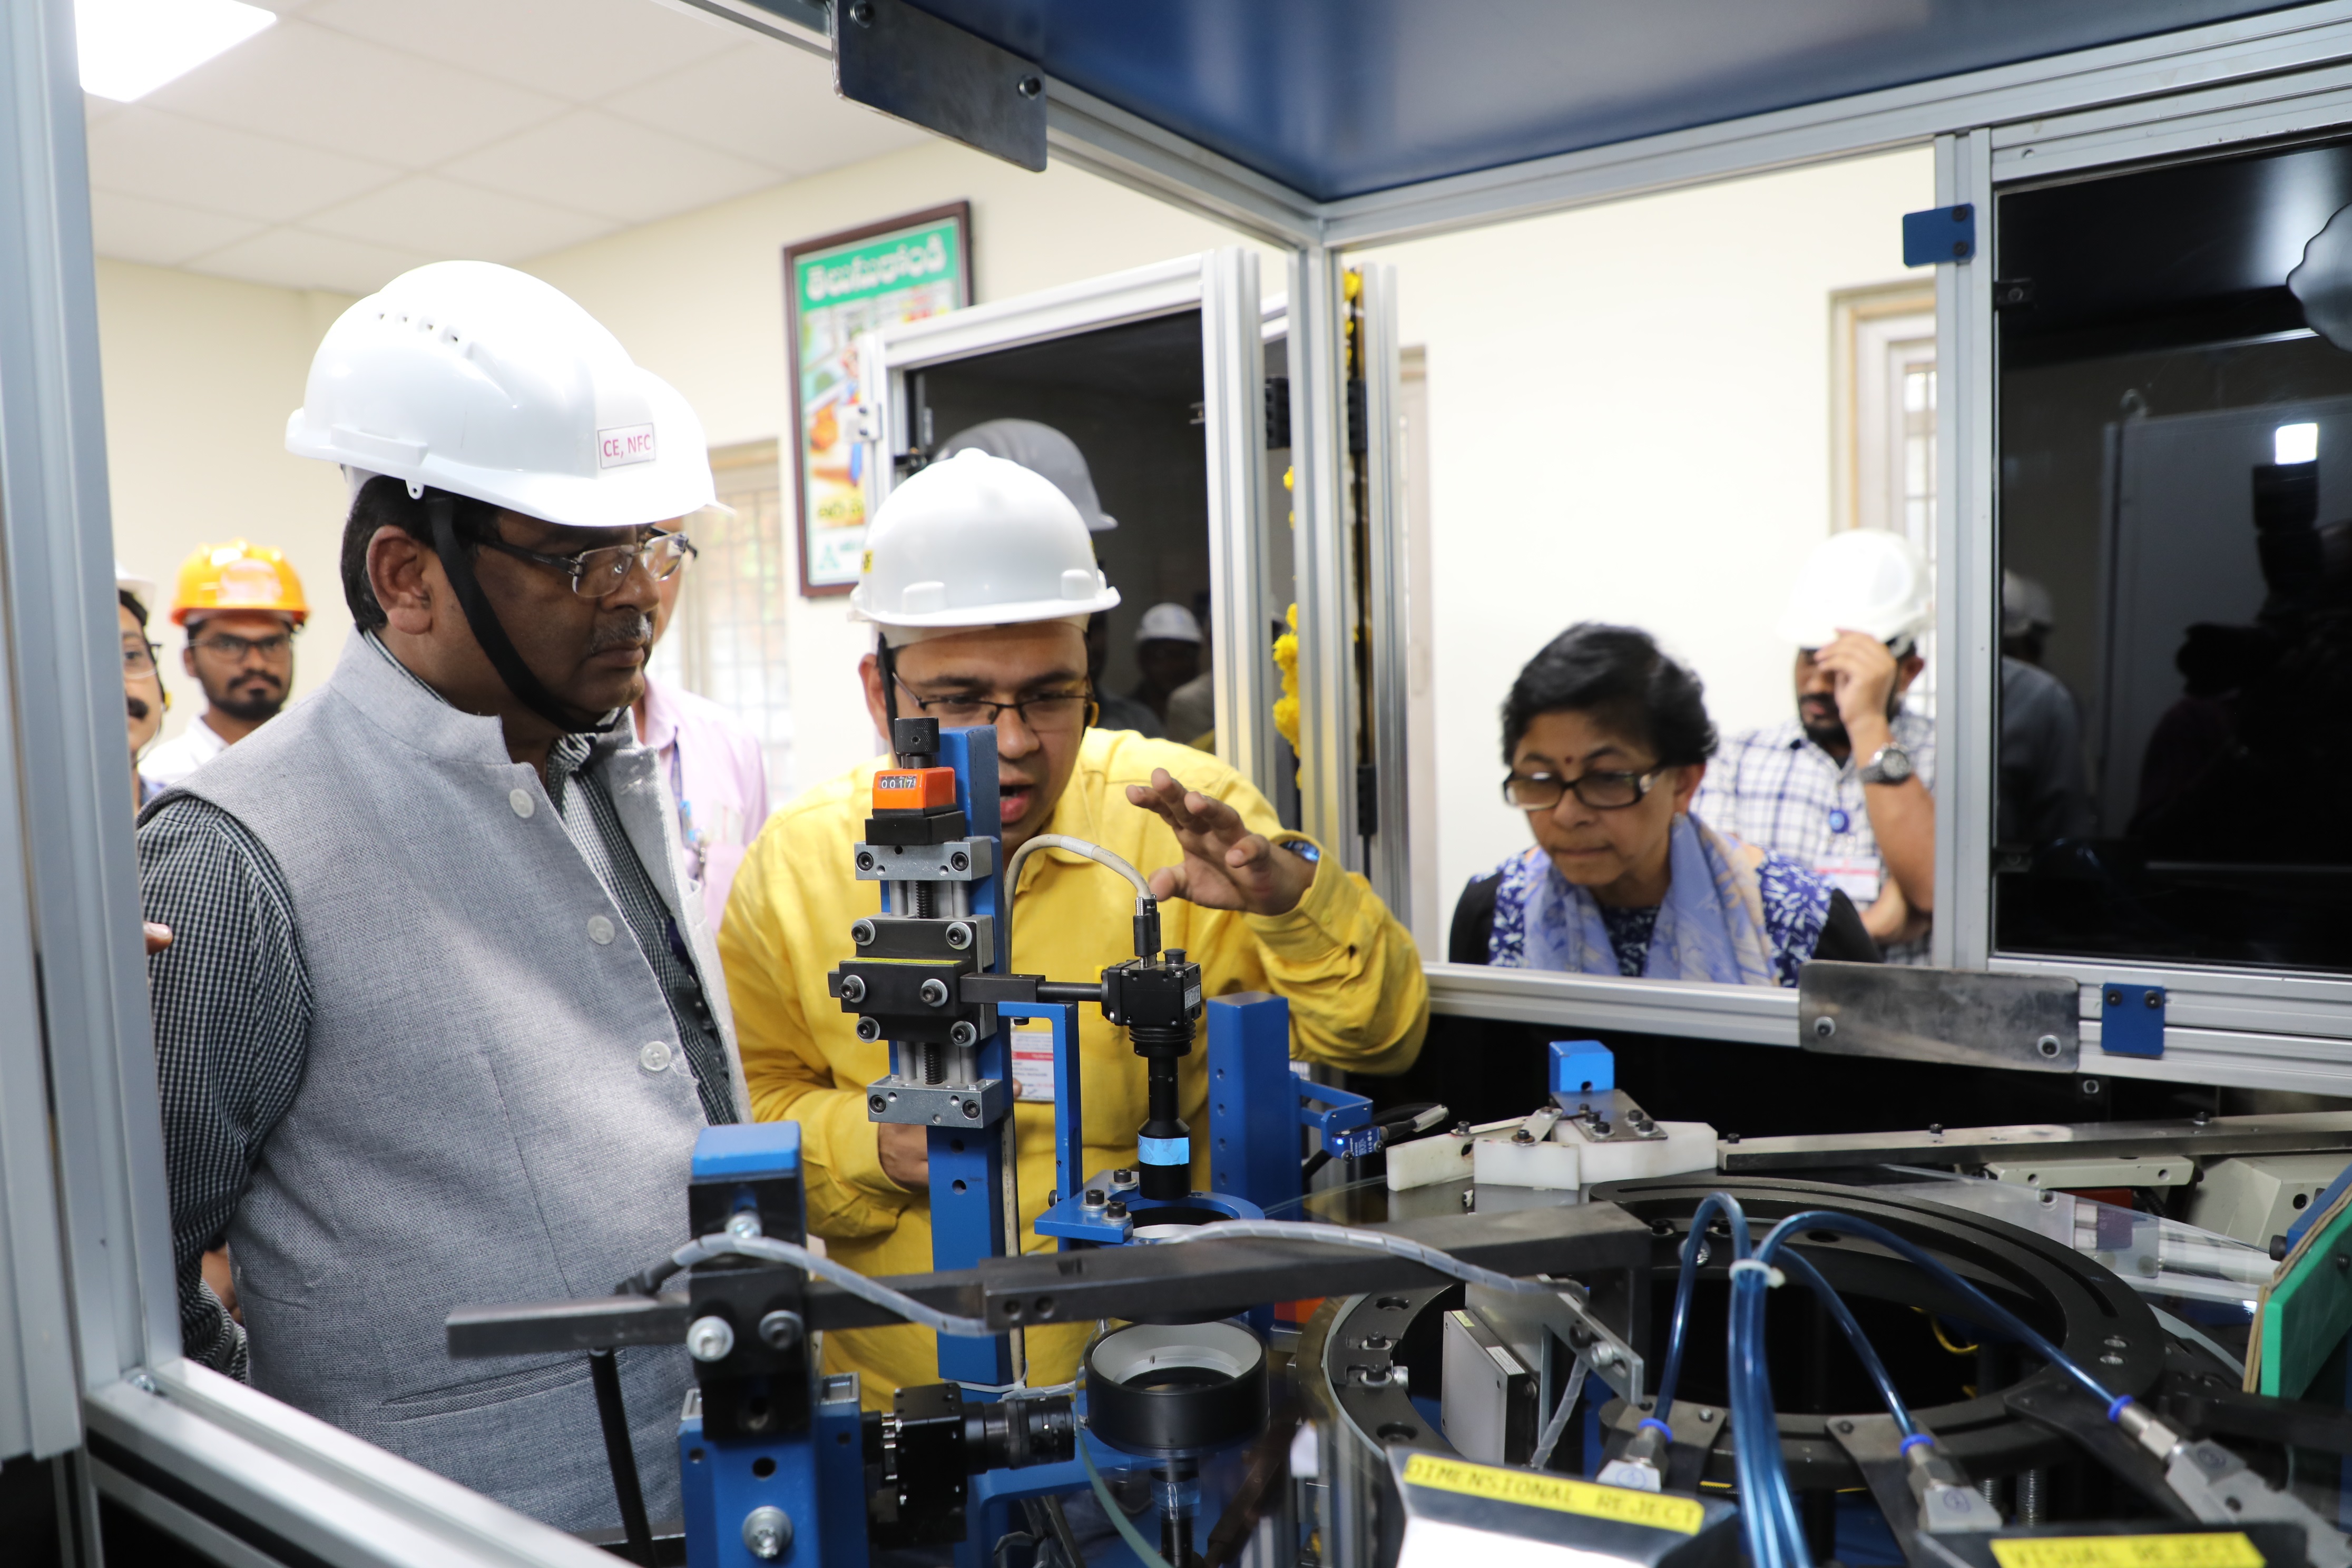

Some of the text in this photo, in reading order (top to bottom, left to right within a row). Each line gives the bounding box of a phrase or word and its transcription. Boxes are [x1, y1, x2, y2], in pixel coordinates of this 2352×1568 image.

[603, 434, 651, 458] CE, NFC
[1406, 1459, 1573, 1503] DIMENSIONAL
[1596, 1492, 1697, 1525] REJECT
